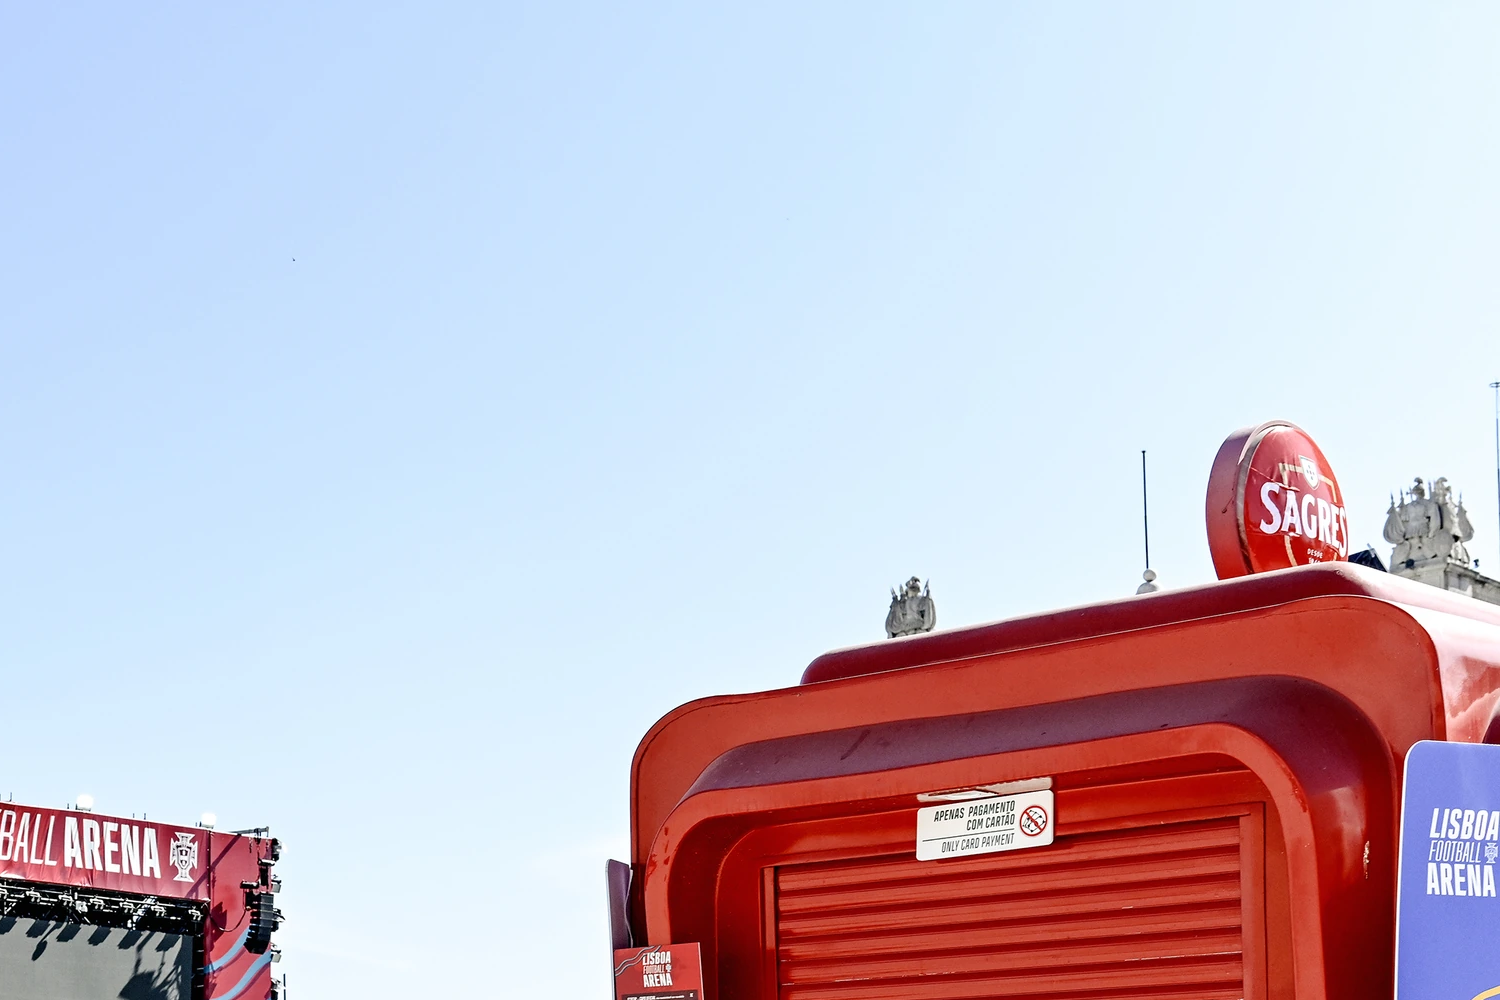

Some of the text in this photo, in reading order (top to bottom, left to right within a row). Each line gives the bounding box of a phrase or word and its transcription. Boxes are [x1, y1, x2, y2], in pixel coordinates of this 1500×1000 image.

[1260, 481, 1348, 558] SAGRES
[934, 800, 1015, 822] APENAS PAGAMENTO
[966, 812, 1015, 831] COM CARTÃO
[1429, 808, 1500, 841] LISBOA
[64, 816, 162, 878] ARENA
[941, 833, 1015, 853] ONLY CARD PAYMENT
[1429, 840, 1481, 863] FOOTBALL
[1426, 862, 1497, 897] ARENA
[642, 951, 671, 966] LISBOA
[643, 973, 673, 987] ARENA
